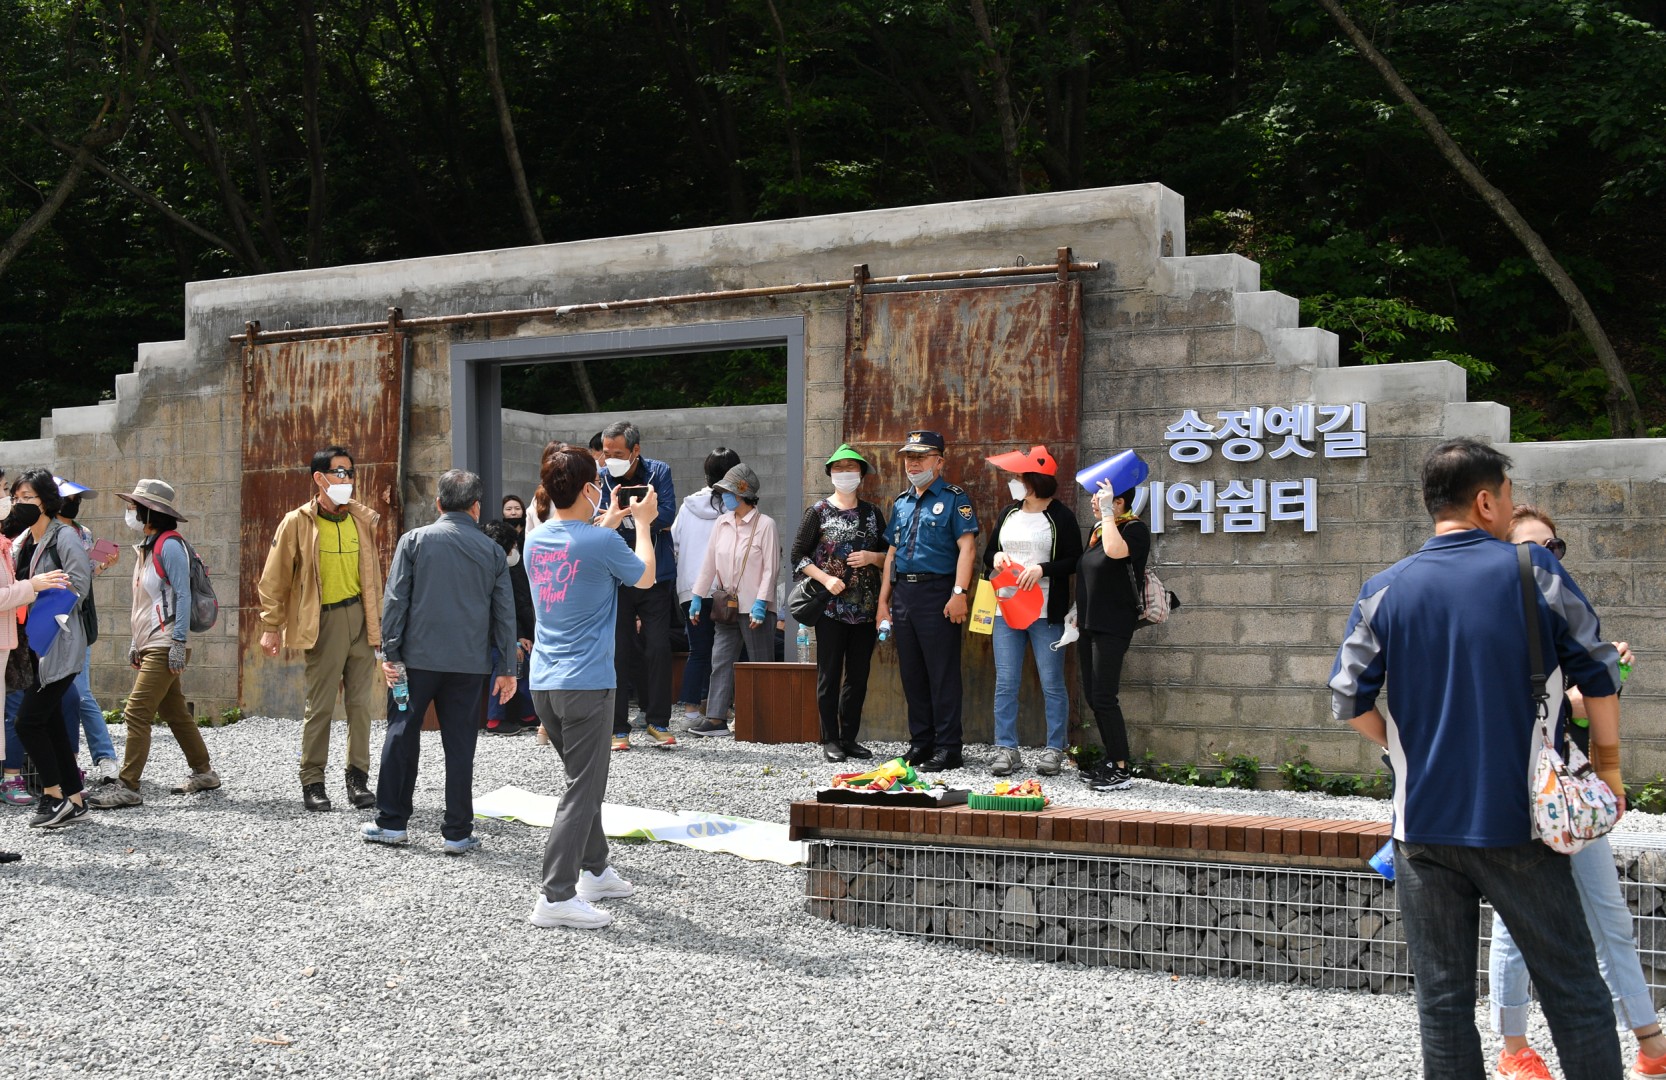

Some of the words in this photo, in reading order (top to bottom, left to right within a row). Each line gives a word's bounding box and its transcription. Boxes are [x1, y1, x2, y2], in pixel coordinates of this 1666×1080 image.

[1164, 402, 1367, 463] 송정옛길
[1131, 478, 1318, 534] 기억쉼터
[556, 559, 581, 585] Of
[537, 582, 568, 613] Mind
